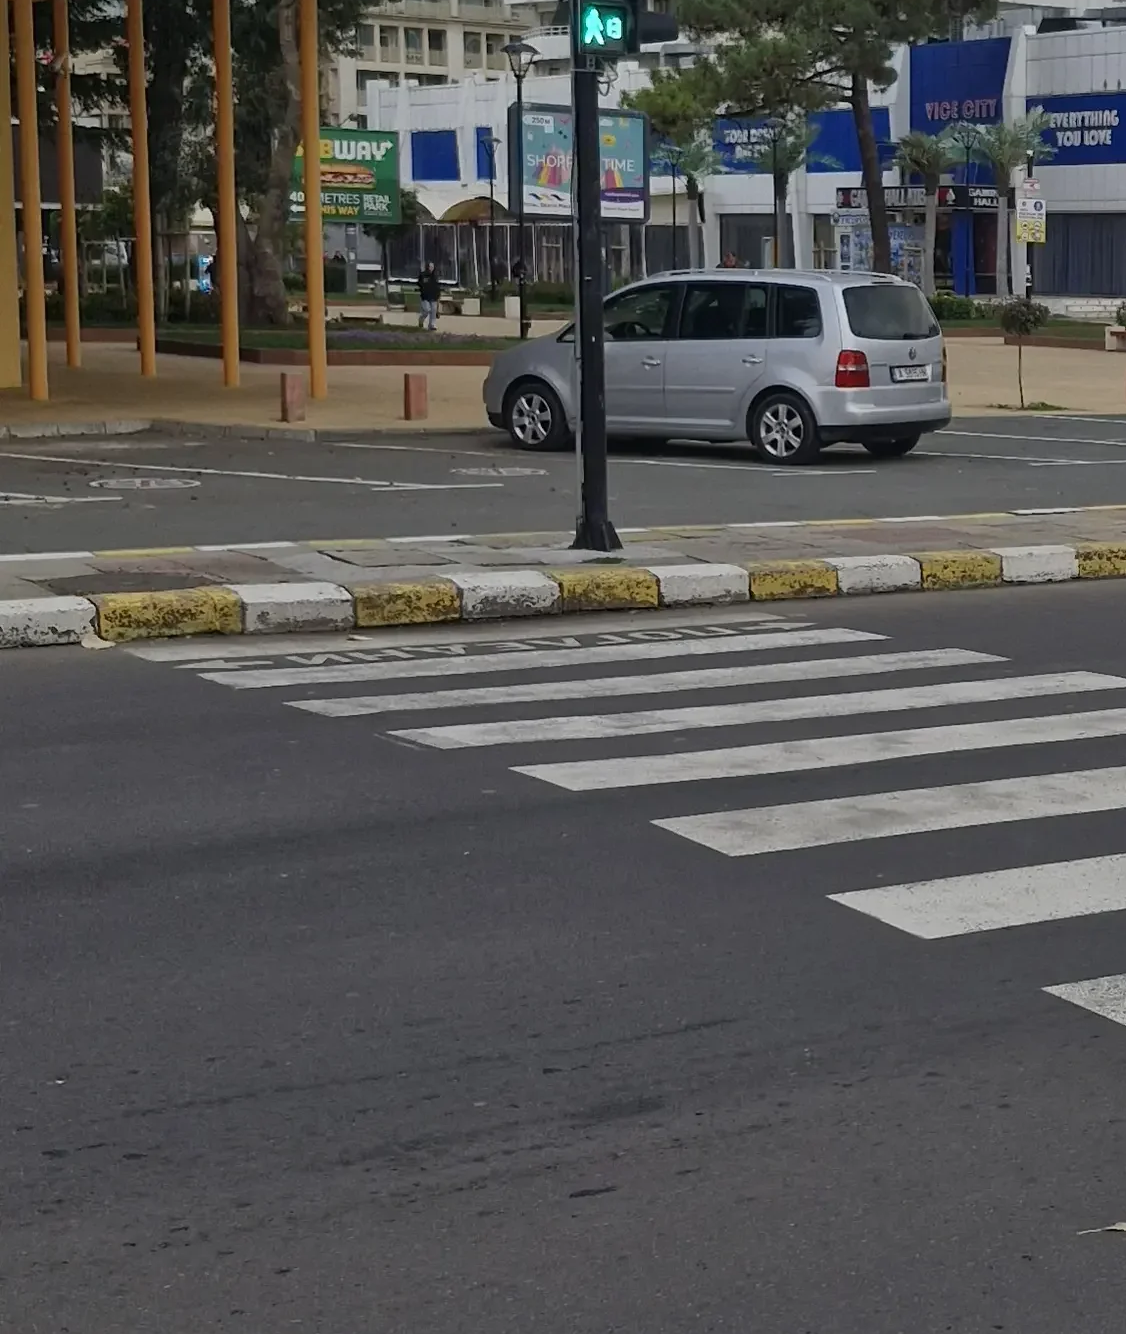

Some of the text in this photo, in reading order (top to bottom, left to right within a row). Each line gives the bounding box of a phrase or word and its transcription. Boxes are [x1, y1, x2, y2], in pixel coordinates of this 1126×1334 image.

[925, 98, 997, 120] VICE CITY
[1049, 109, 1119, 128] EVERYTHING
[1056, 129, 1112, 147] YOU LOVE
[602, 158, 635, 172] TIME
[338, 205, 360, 215] WAY
[363, 202, 388, 213] PARK
